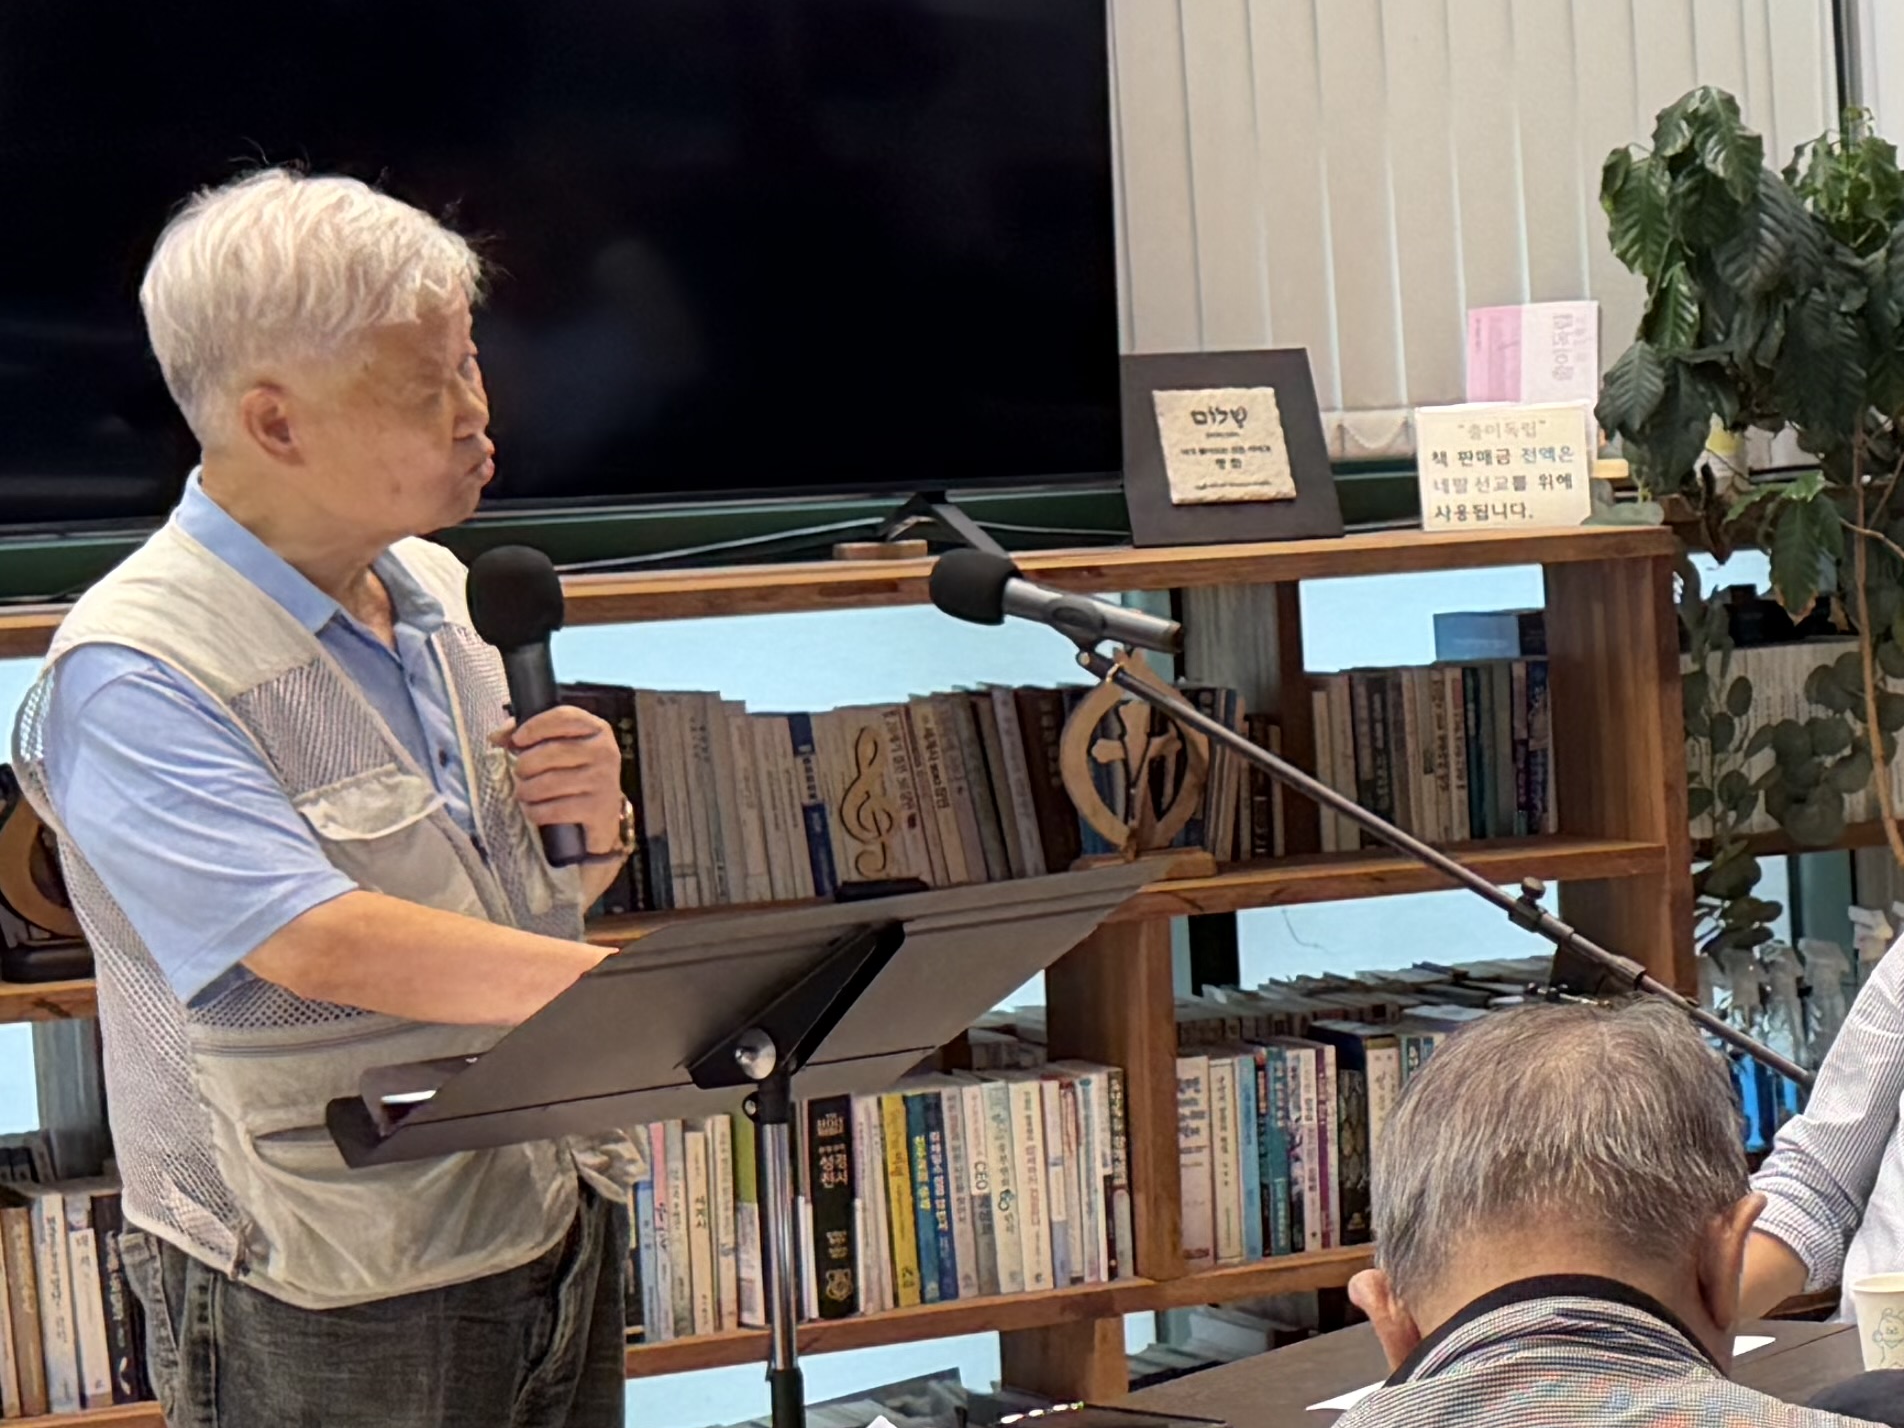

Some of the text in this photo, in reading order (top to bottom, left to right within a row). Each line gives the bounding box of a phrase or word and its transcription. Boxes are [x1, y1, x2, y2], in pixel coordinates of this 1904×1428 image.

[1432, 445, 1574, 467] 책 판매금 전액은
[1474, 474, 1527, 494] 선교를
[1434, 501, 1534, 522] 사용됩니다.
[974, 1161, 988, 1190] CEO
